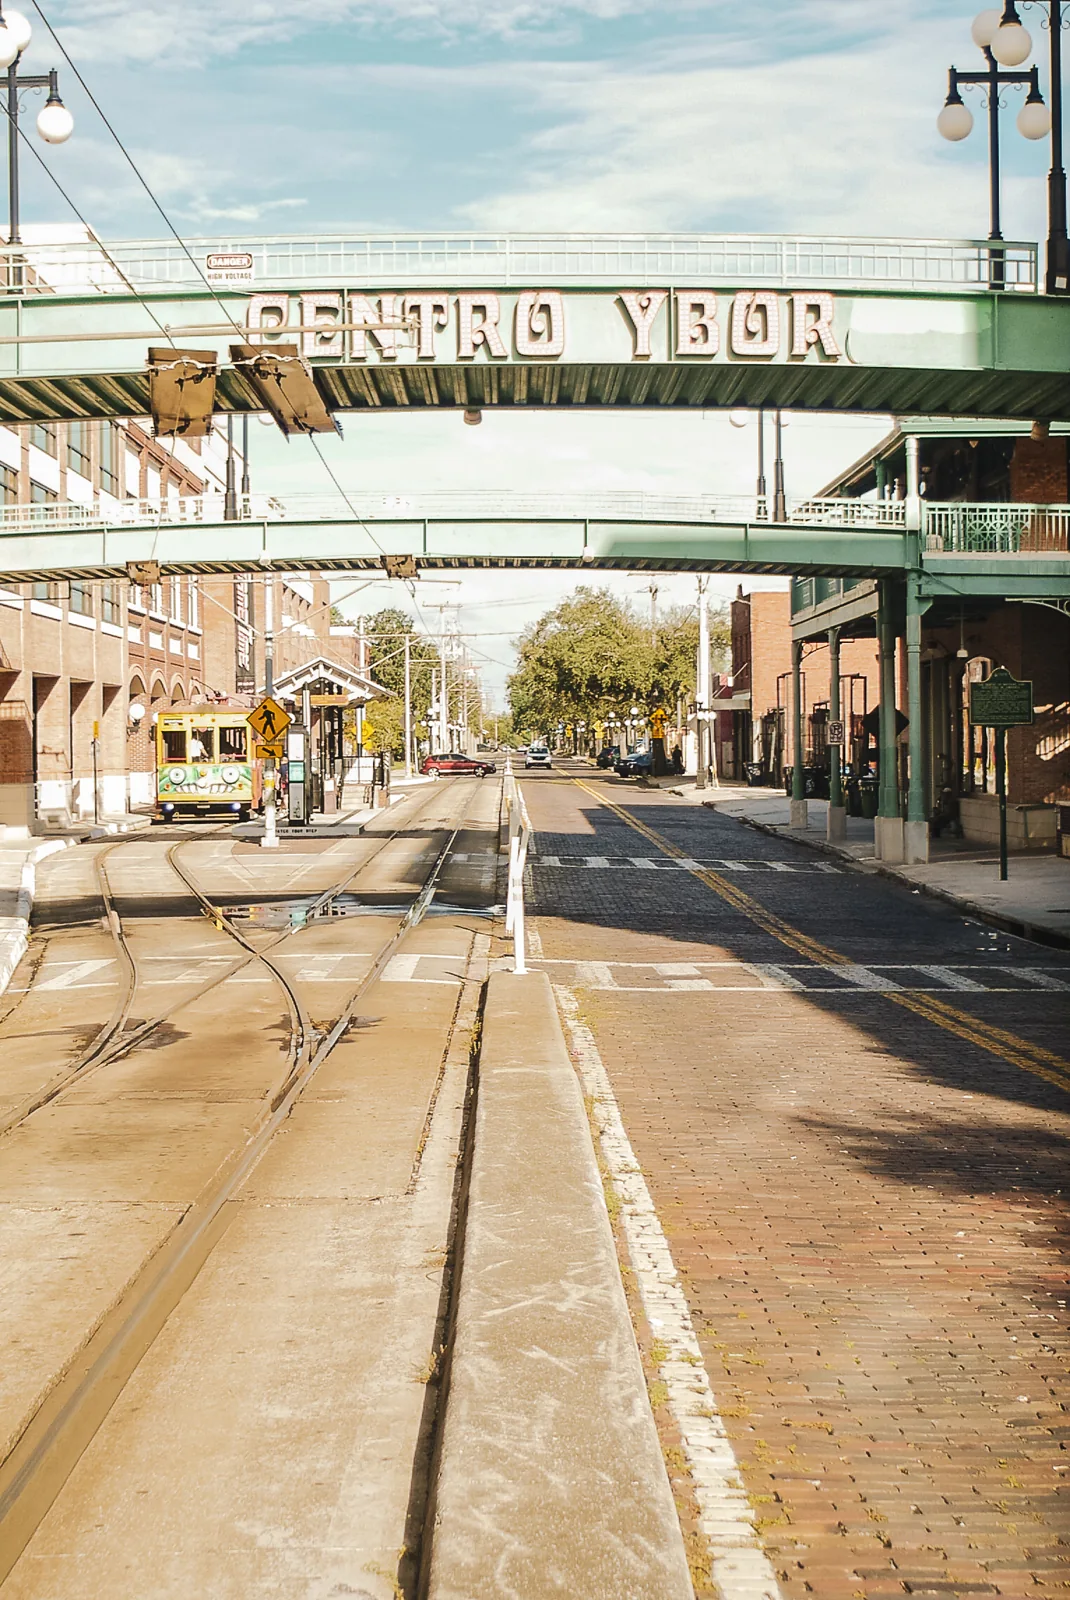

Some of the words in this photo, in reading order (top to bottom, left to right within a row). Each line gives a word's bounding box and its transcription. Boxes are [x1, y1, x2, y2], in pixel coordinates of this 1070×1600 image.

[211, 258, 248, 266] DANGER
[225, 272, 252, 280] VOLTAGE
[247, 291, 565, 358] CENTRO
[615, 290, 842, 357] YBOR
